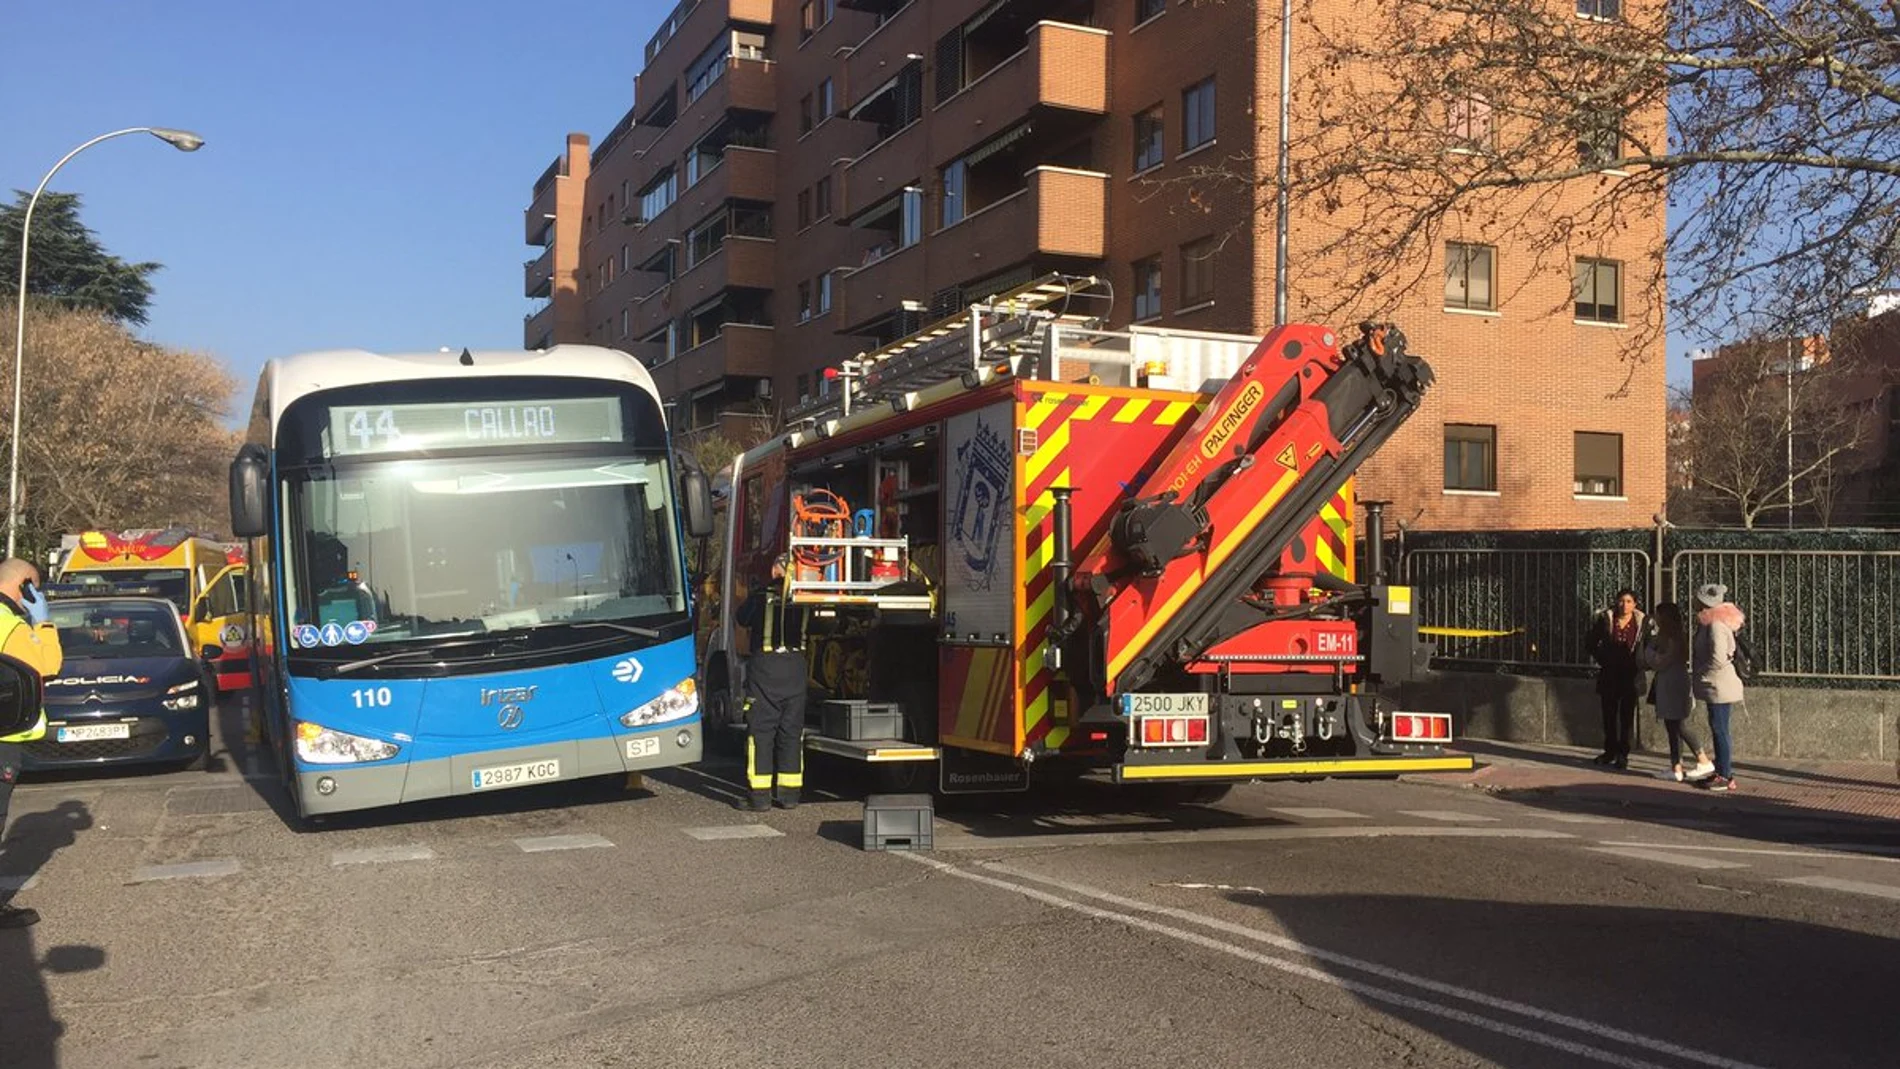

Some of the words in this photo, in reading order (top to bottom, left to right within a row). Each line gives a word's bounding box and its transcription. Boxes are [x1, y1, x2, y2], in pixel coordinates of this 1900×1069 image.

[350, 409, 400, 449] 44
[464, 406, 556, 439] CALLAO
[1204, 385, 1261, 454] PALFINGER
[1318, 632, 1353, 652] EM-11
[352, 687, 392, 708] 110
[1134, 696, 1173, 712] 2500
[1177, 695, 1205, 712] JKY
[631, 739, 656, 755] SP
[484, 767, 523, 786] 2987
[527, 762, 556, 779] KGC
